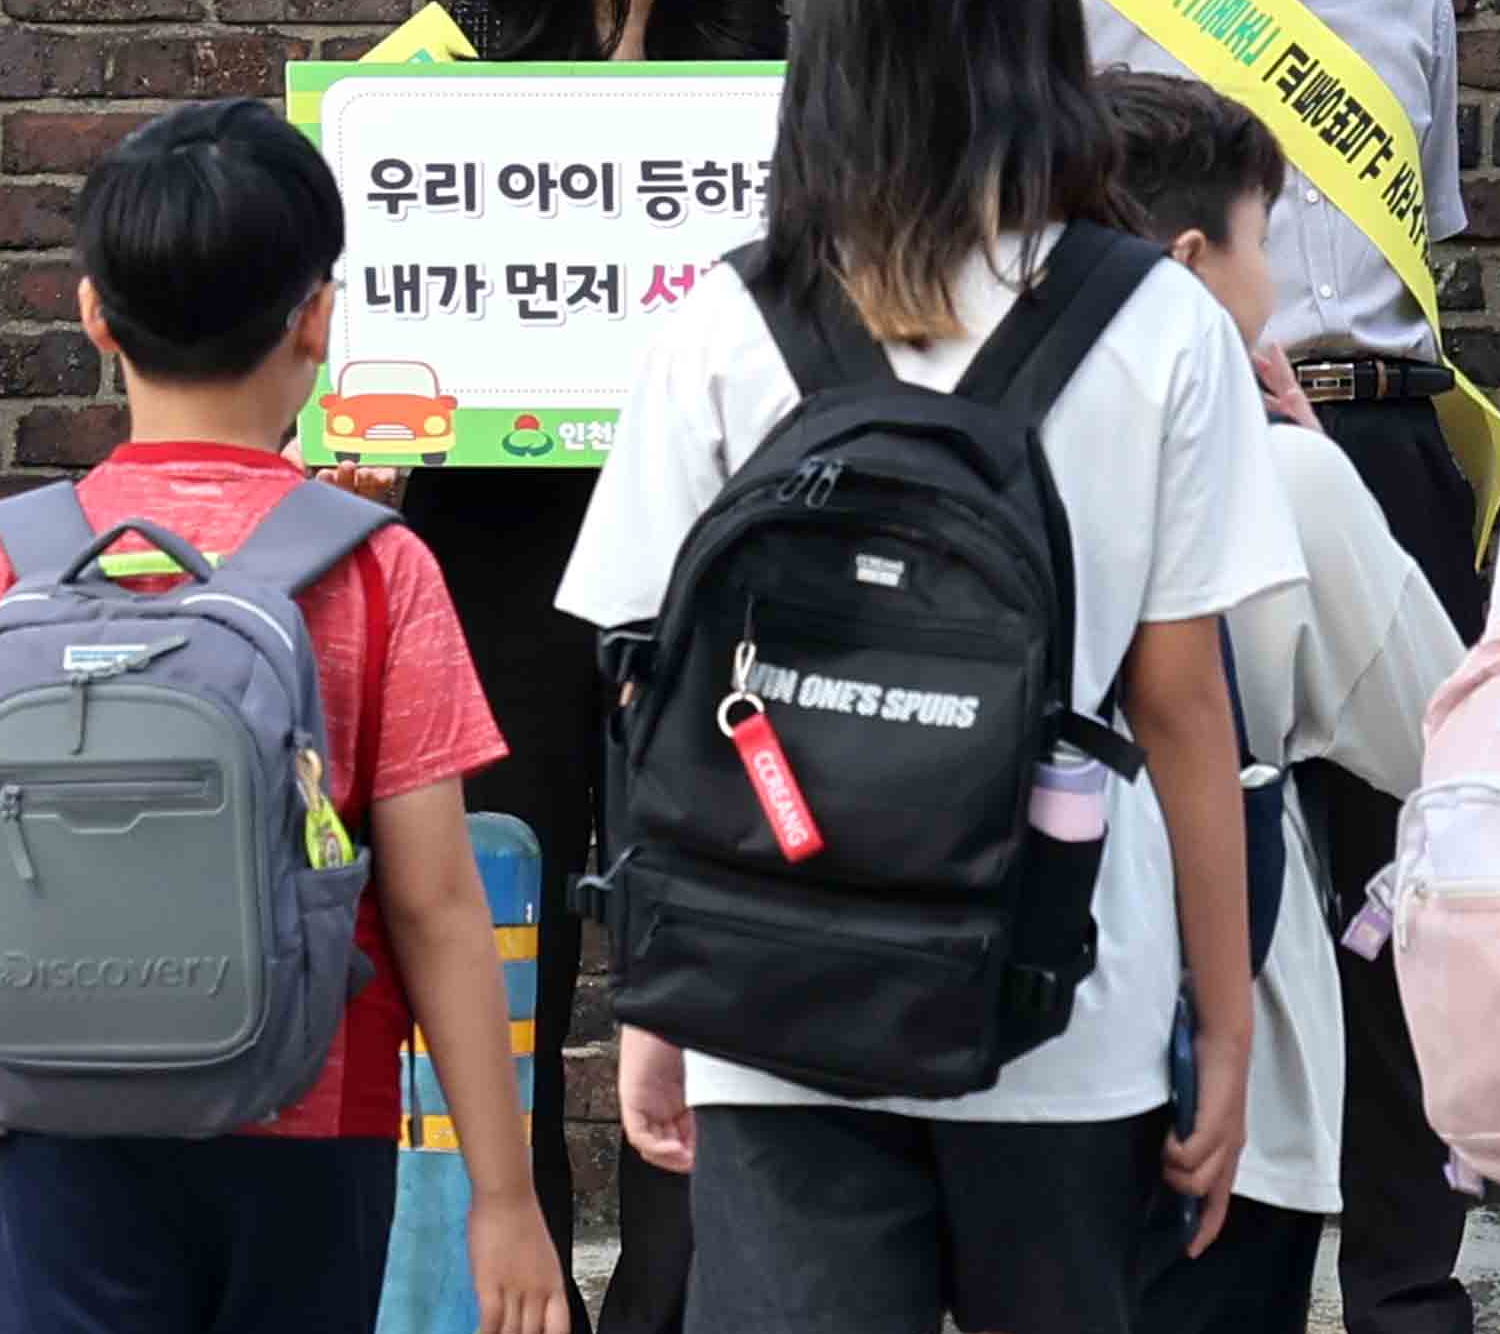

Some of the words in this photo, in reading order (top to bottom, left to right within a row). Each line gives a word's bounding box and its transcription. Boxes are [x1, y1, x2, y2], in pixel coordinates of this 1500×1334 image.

[1262, 43, 1394, 181] 교통법규
[366, 158, 477, 214] 우리
[497, 161, 615, 213] 아이
[364, 263, 486, 314] 내가
[505, 262, 619, 319] 먼저
[559, 421, 617, 451] 인천
[881, 688, 980, 728] SPURS
